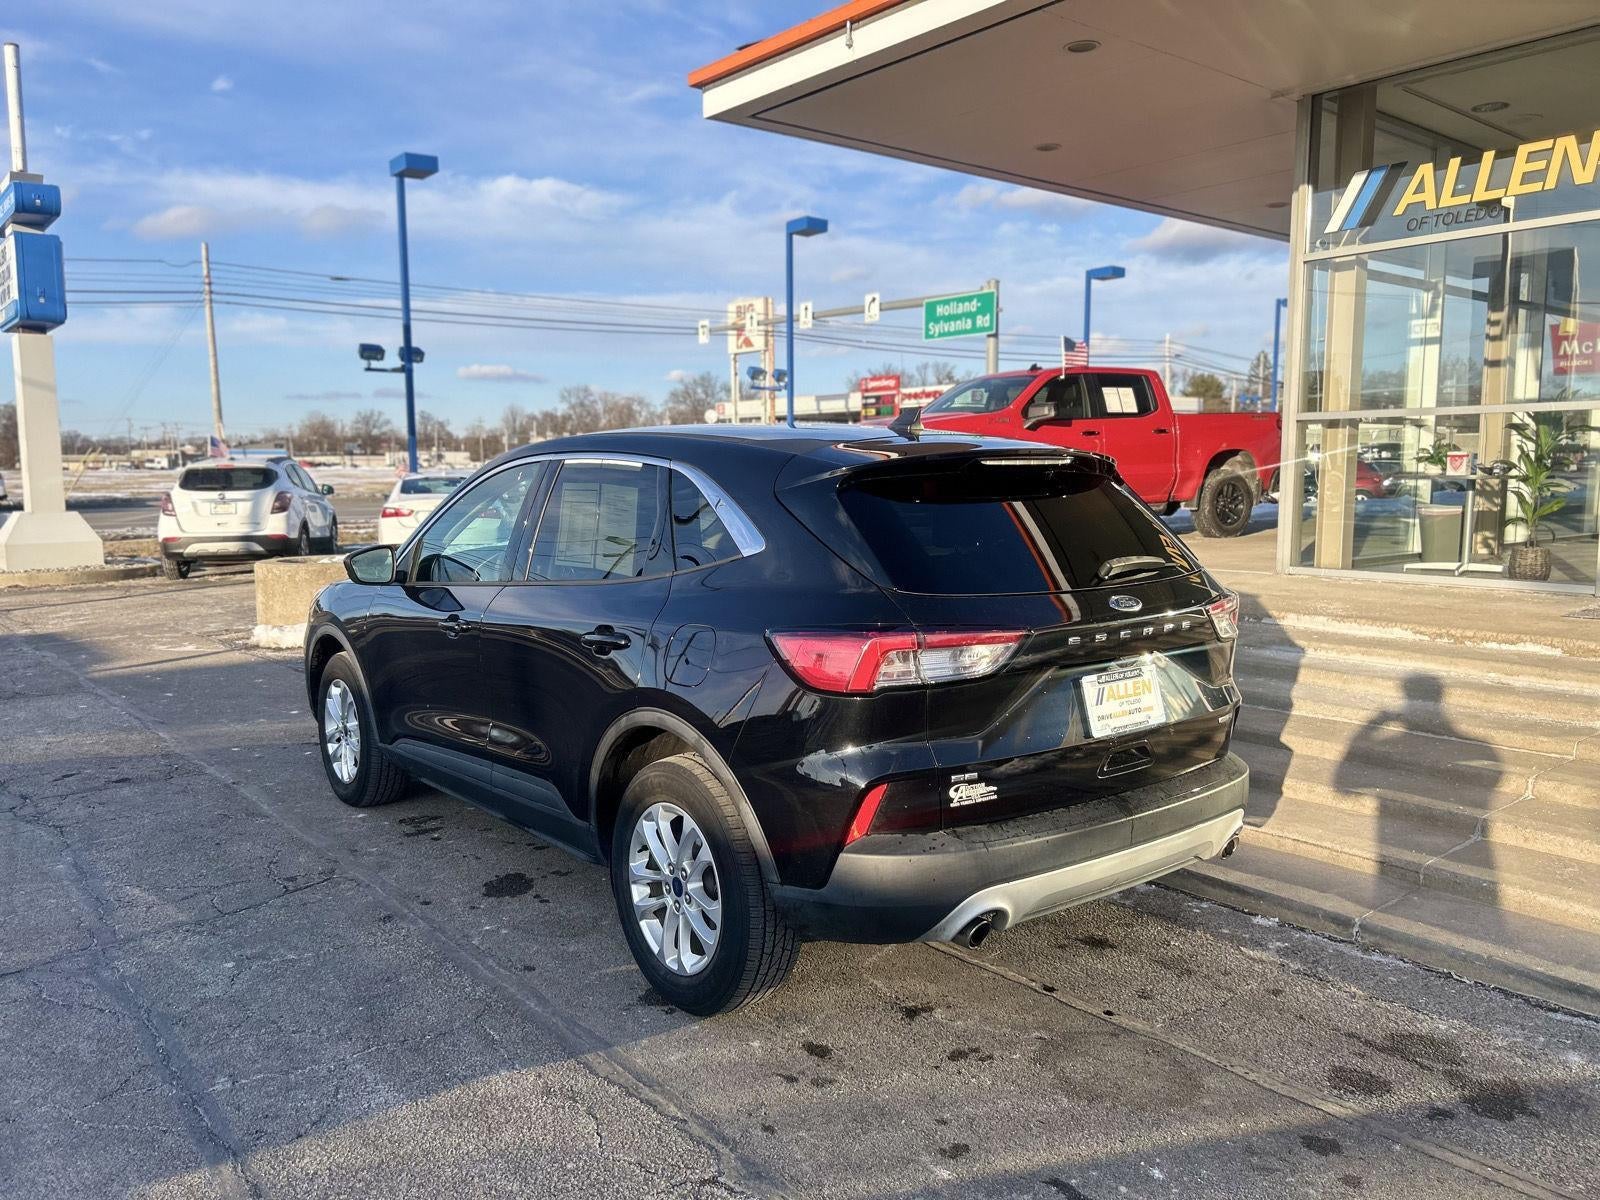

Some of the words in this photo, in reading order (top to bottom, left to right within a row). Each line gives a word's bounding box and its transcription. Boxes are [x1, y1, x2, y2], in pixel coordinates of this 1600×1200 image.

[1392, 129, 1600, 217] ALLEN
[1406, 216, 1431, 232] OF
[1432, 204, 1503, 228] TOLEDO
[936, 297, 982, 317] Holland-
[928, 317, 973, 337] Sylvania
[976, 313, 991, 328] Rd
[1068, 620, 1191, 645] ESCAPE
[1106, 679, 1152, 702] ALLEN
